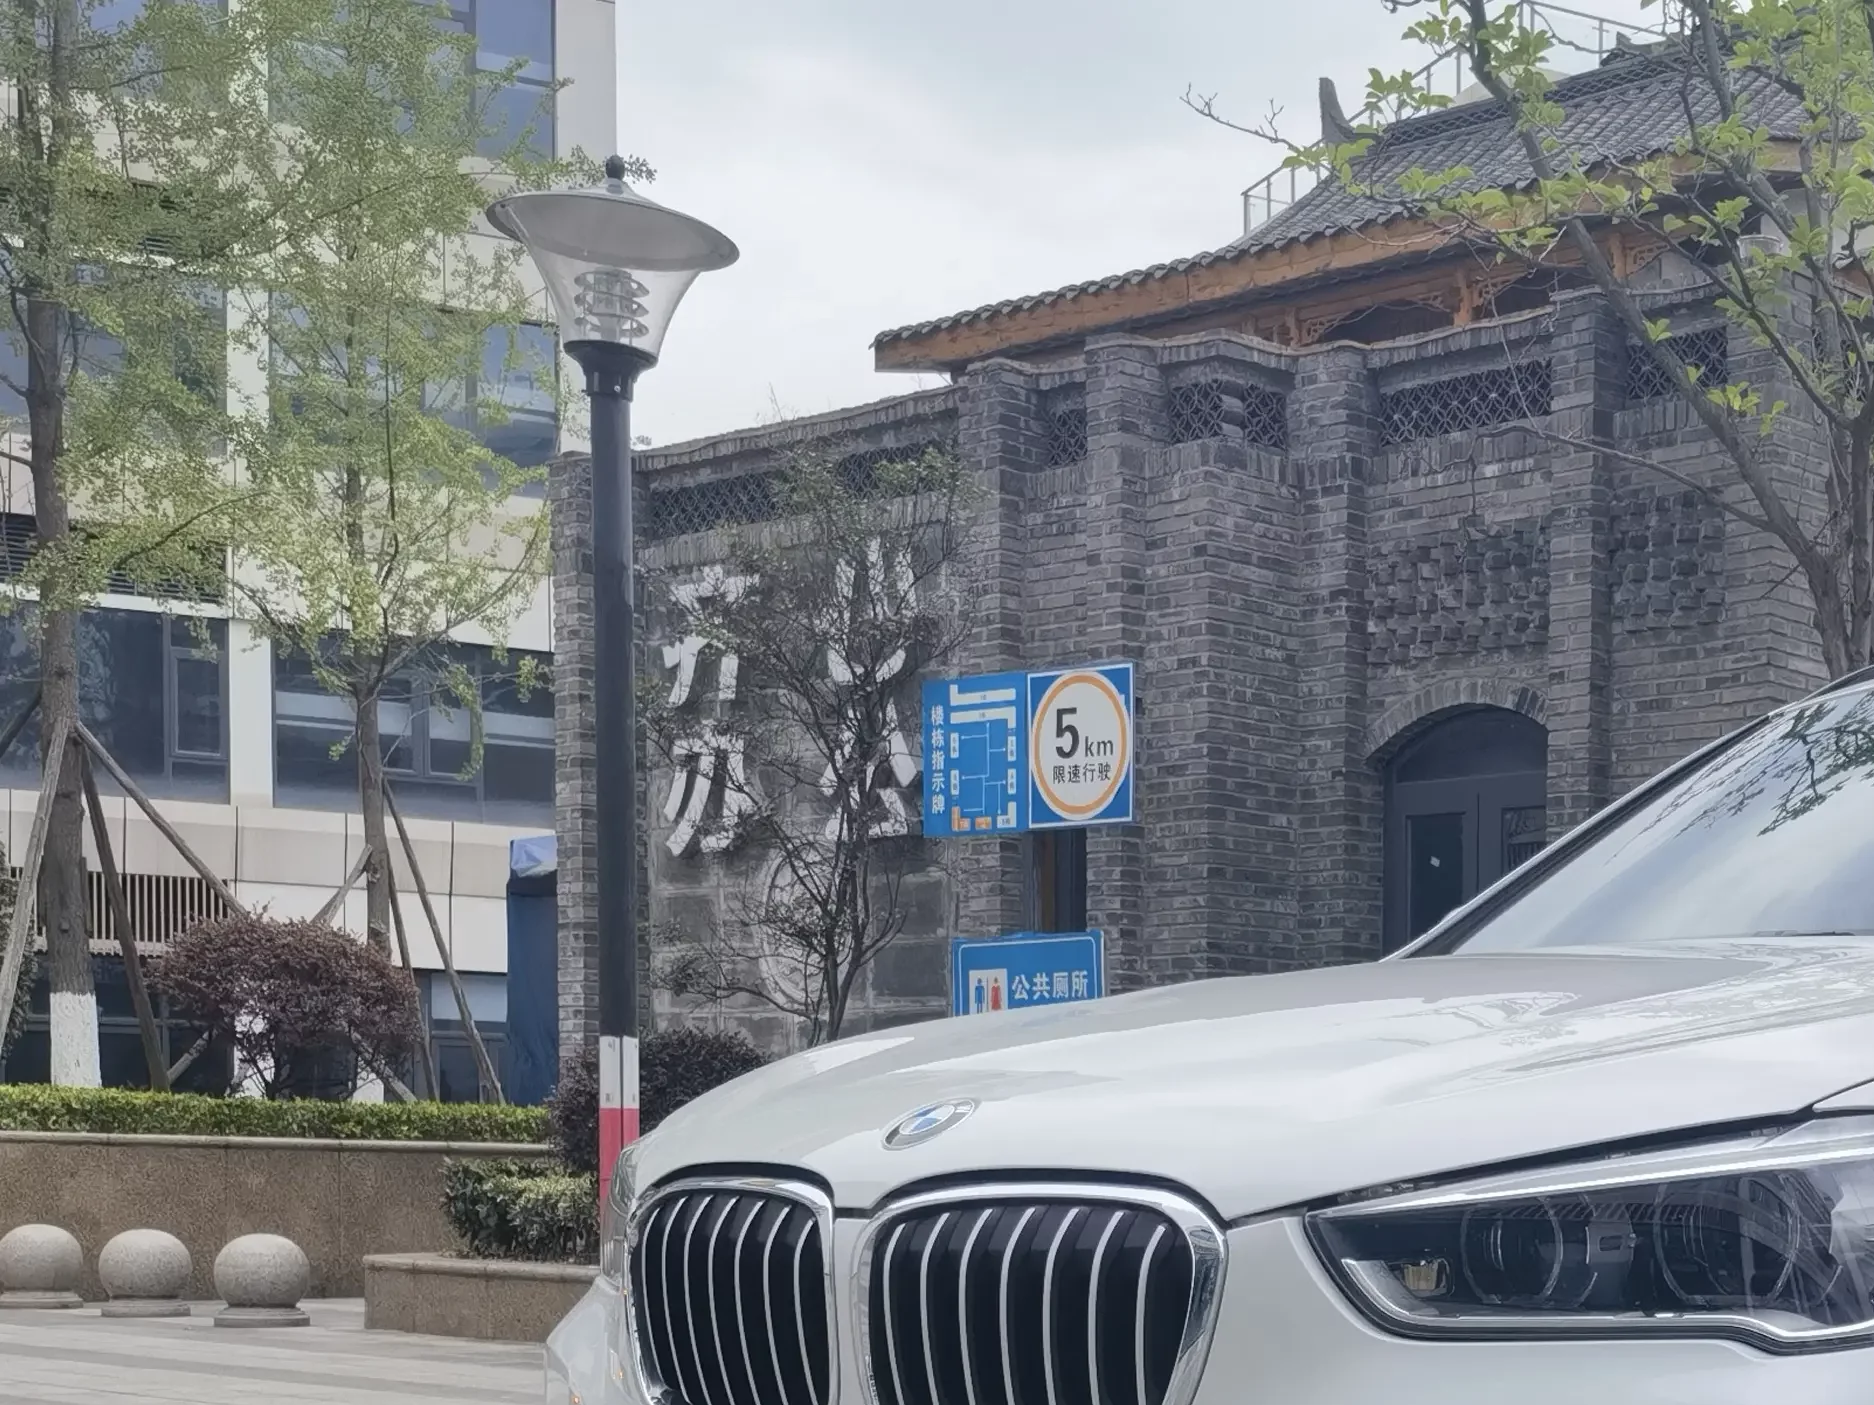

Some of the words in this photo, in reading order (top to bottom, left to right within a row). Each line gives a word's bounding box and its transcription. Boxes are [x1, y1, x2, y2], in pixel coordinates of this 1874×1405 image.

[1055, 706, 1080, 760] 5
[1084, 736, 1114, 758] km
[931, 704, 946, 814] 楼栋指示牌
[1052, 762, 1112, 785] 限速行驶
[1011, 969, 1089, 1001] 公共厕所
